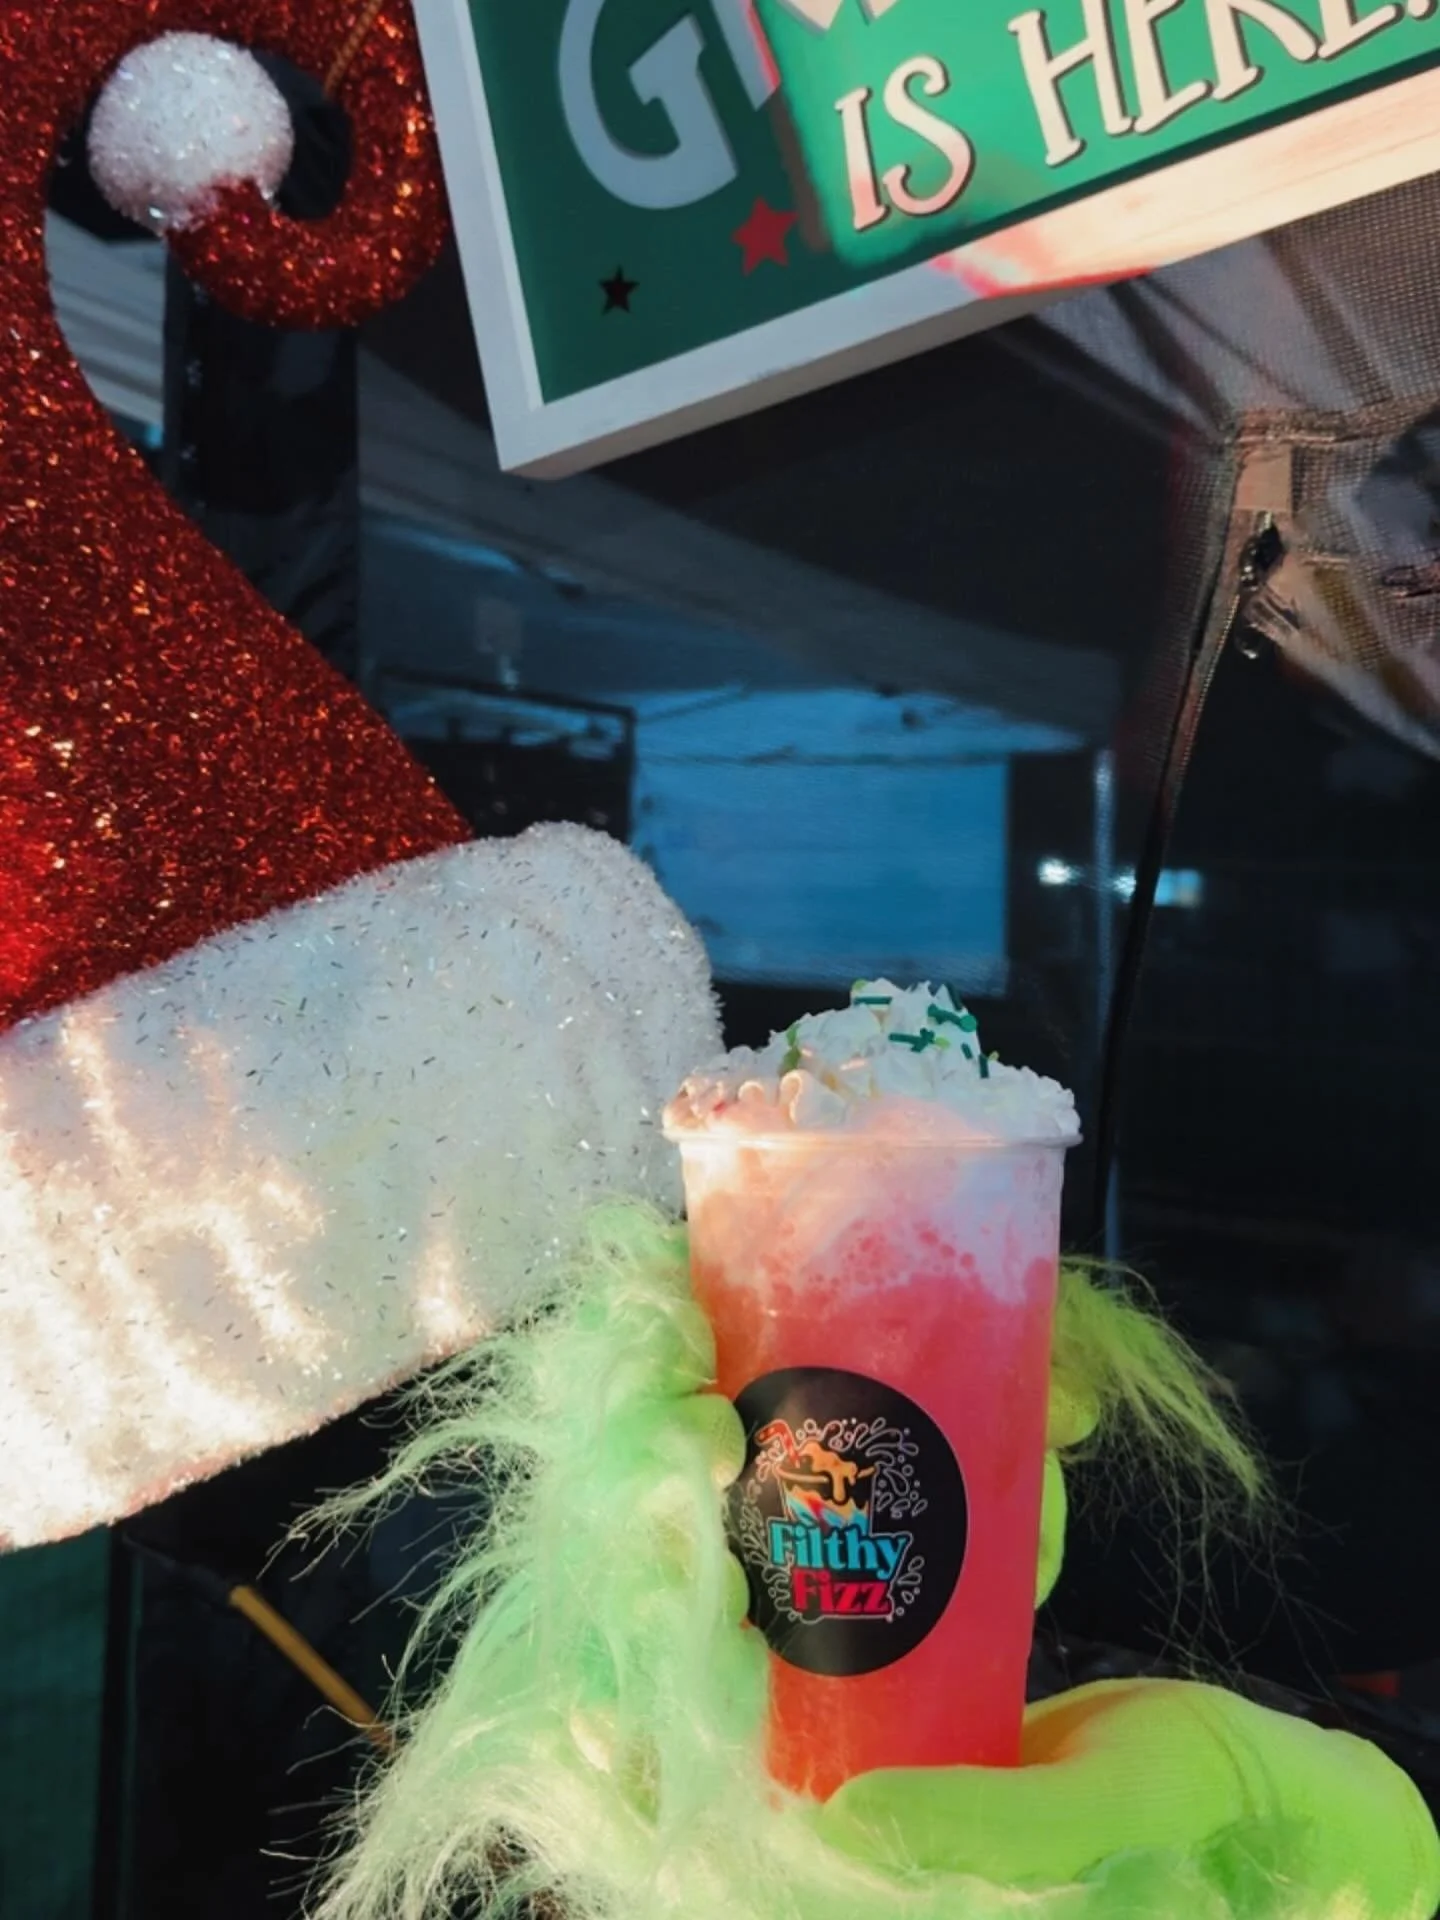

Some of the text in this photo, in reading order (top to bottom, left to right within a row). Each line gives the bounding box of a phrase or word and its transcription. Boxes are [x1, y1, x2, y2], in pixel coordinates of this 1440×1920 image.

[834, 54, 975, 232] IS
[769, 1521, 907, 1580] Filthy
[791, 1567, 890, 1615] Fizz
